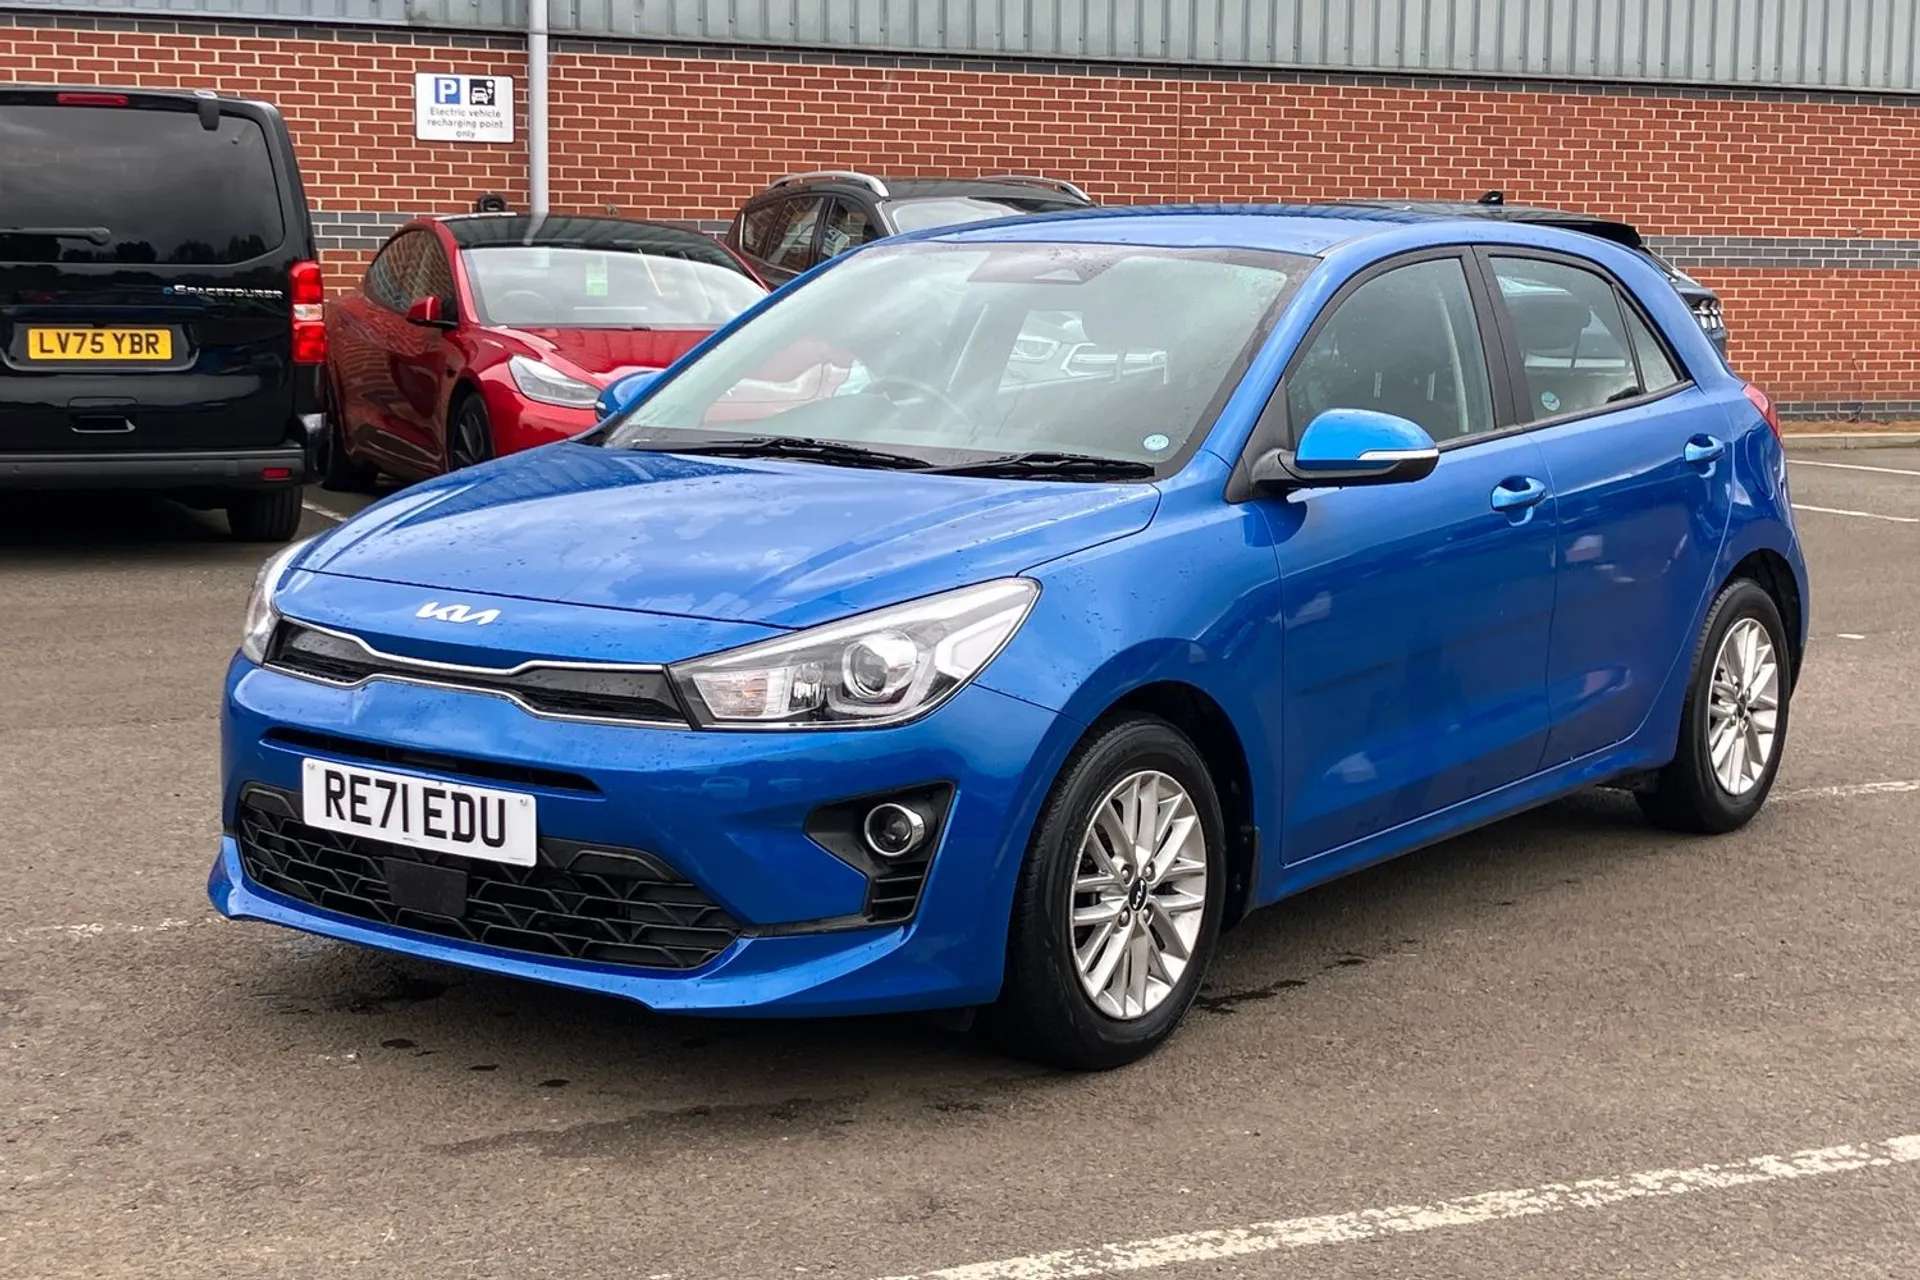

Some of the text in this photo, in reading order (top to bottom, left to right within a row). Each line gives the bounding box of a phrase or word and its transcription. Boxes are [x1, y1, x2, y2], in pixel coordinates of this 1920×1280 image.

[439, 79, 457, 103] P
[430, 107, 501, 118] Electric vehicle
[427, 119, 503, 129] recharging point
[456, 130, 476, 138] only
[39, 333, 159, 354] LV75 YBR
[325, 769, 506, 848] RE71 EDU
